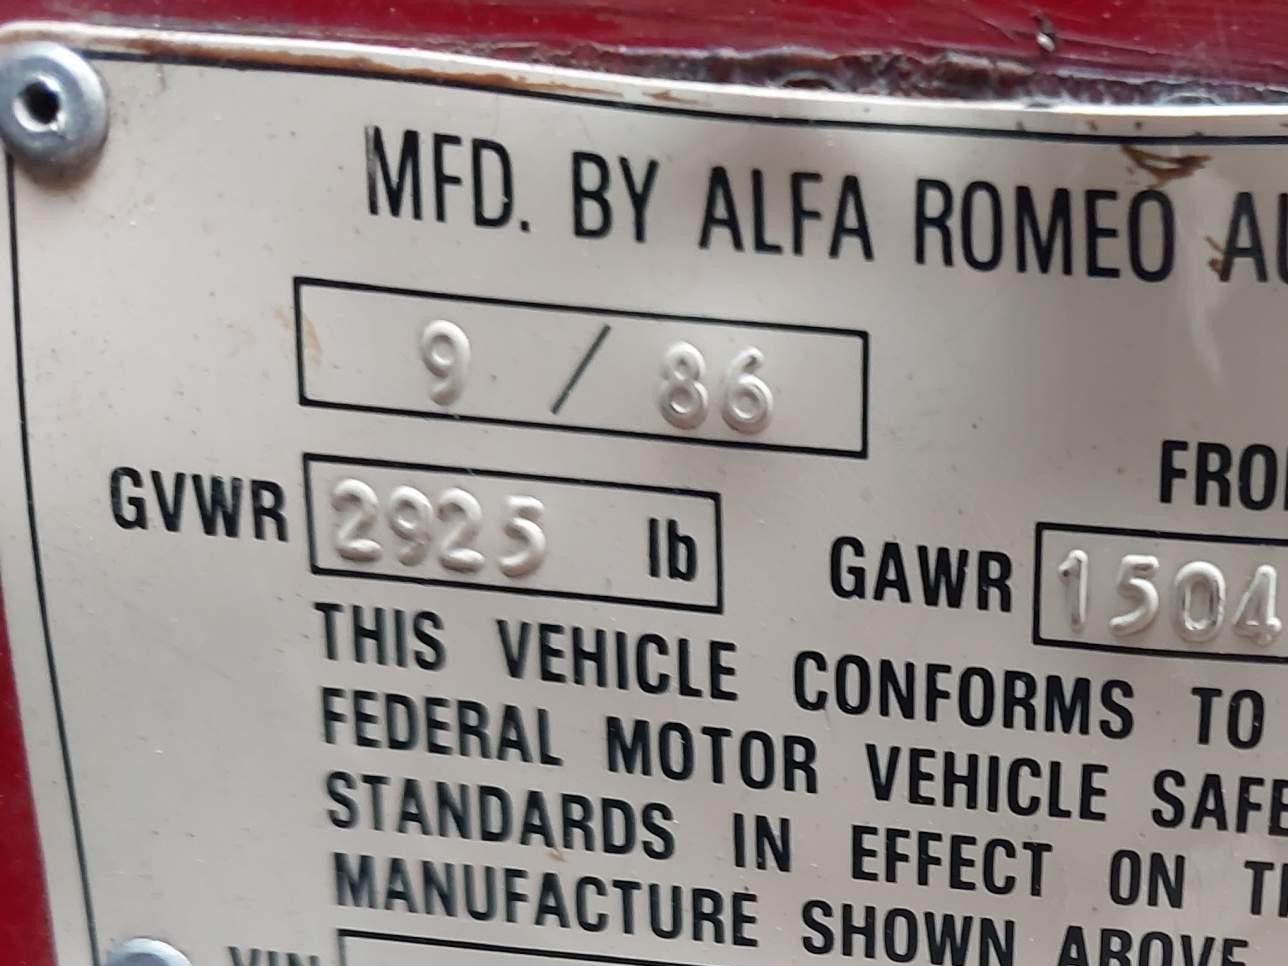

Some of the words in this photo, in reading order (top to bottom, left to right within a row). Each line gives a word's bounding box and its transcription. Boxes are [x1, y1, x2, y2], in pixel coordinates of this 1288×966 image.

[364, 125, 531, 233] MFD.
[571, 152, 660, 243] BY
[699, 166, 875, 262] ALFA
[914, 178, 1176, 283] ROMEO
[420, 320, 471, 406] 9
[659, 340, 774, 435] 86
[109, 465, 289, 543] GVWR
[330, 477, 547, 578] 2925
[648, 517, 698, 581] lb
[829, 536, 1012, 613] GAWR
[1057, 548, 1283, 646] 1504
[314, 602, 447, 671] THIS
[496, 619, 738, 702] VEHICLE
[793, 650, 1134, 740] CONFORMS
[1191, 687, 1265, 749] TO
[320, 687, 563, 768] FEDERAL
[606, 717, 819, 797] MOTOR
[866, 742, 1109, 822] VEHICLE
[326, 771, 676, 861] STANDARDS
[733, 812, 792, 873] IN
[852, 824, 1052, 898] EFFECT
[1109, 848, 1185, 909] ON
[332, 851, 760, 949] MANUFACTURE
